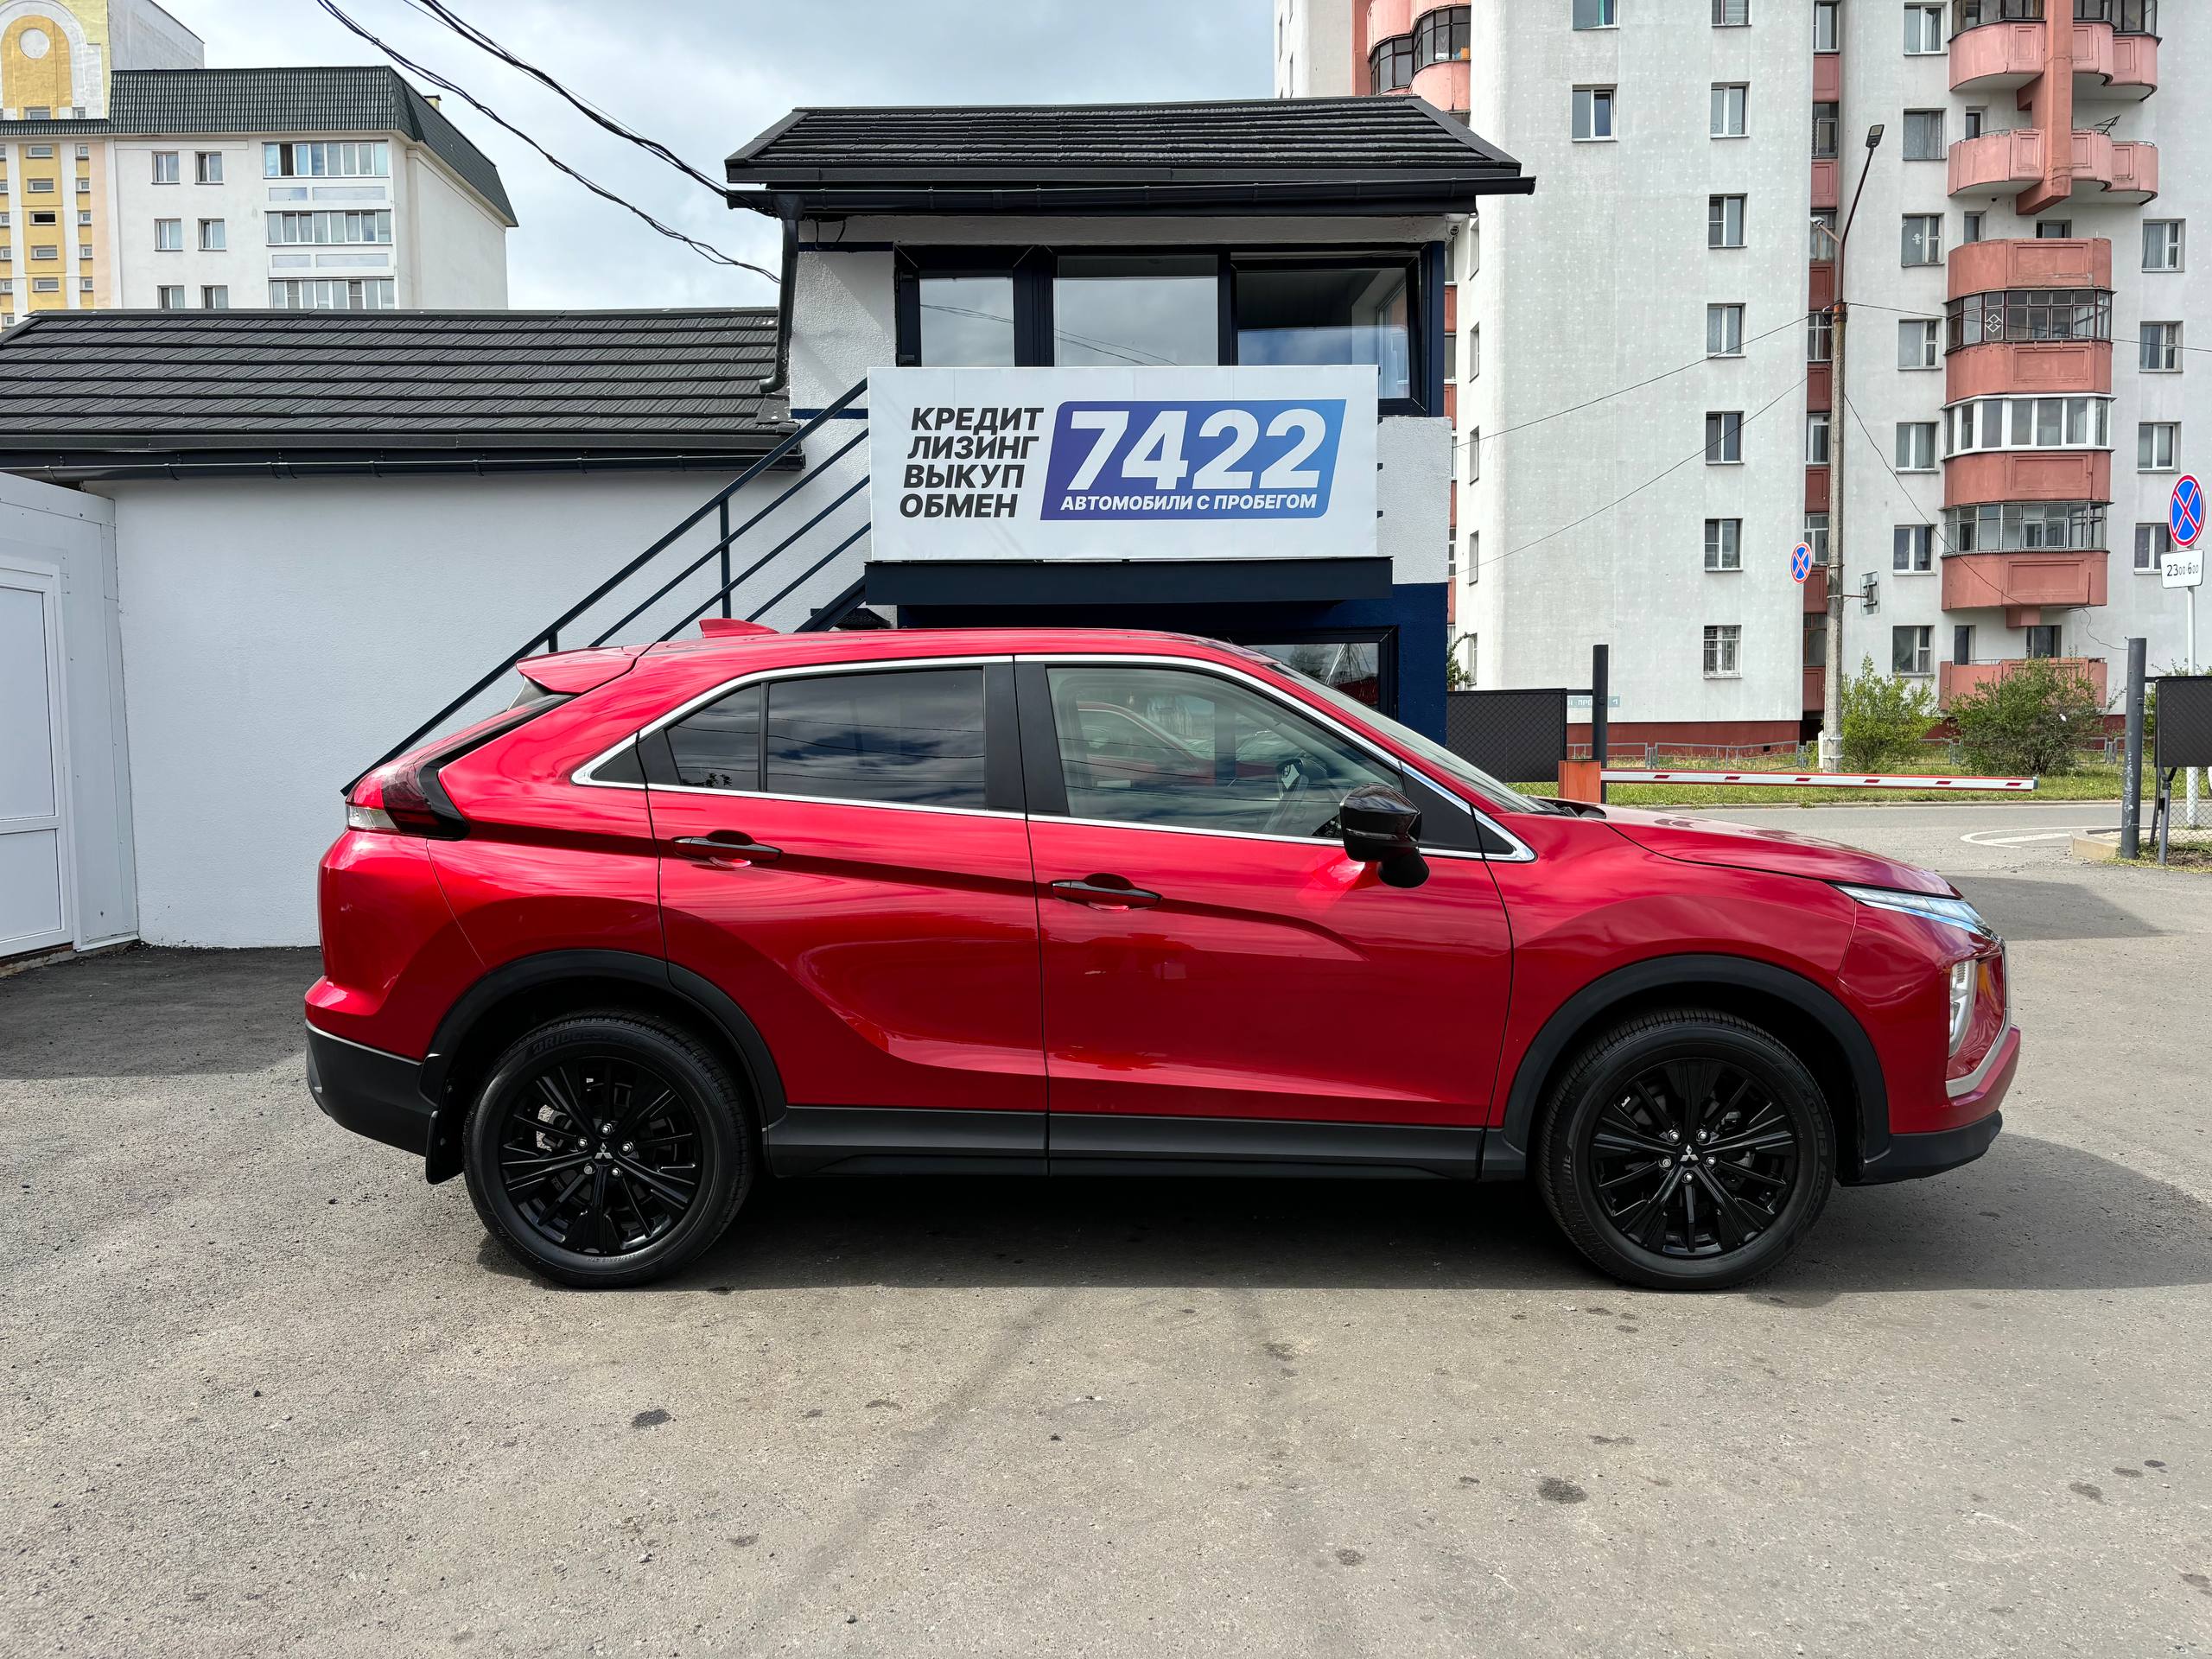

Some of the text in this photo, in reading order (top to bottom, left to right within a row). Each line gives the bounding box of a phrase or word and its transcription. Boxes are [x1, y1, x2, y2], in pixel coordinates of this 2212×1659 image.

[912, 408, 1044, 435] КРЕДИТ
[907, 435, 1039, 460] ЛИЗИНГ
[1067, 408, 1327, 490] 7422
[903, 464, 1026, 489] ВЫКУП
[899, 493, 1019, 518] ОБМЕН
[1060, 494, 1317, 512] АВТОМОБИЛИ С ПРОБЕГОМ
